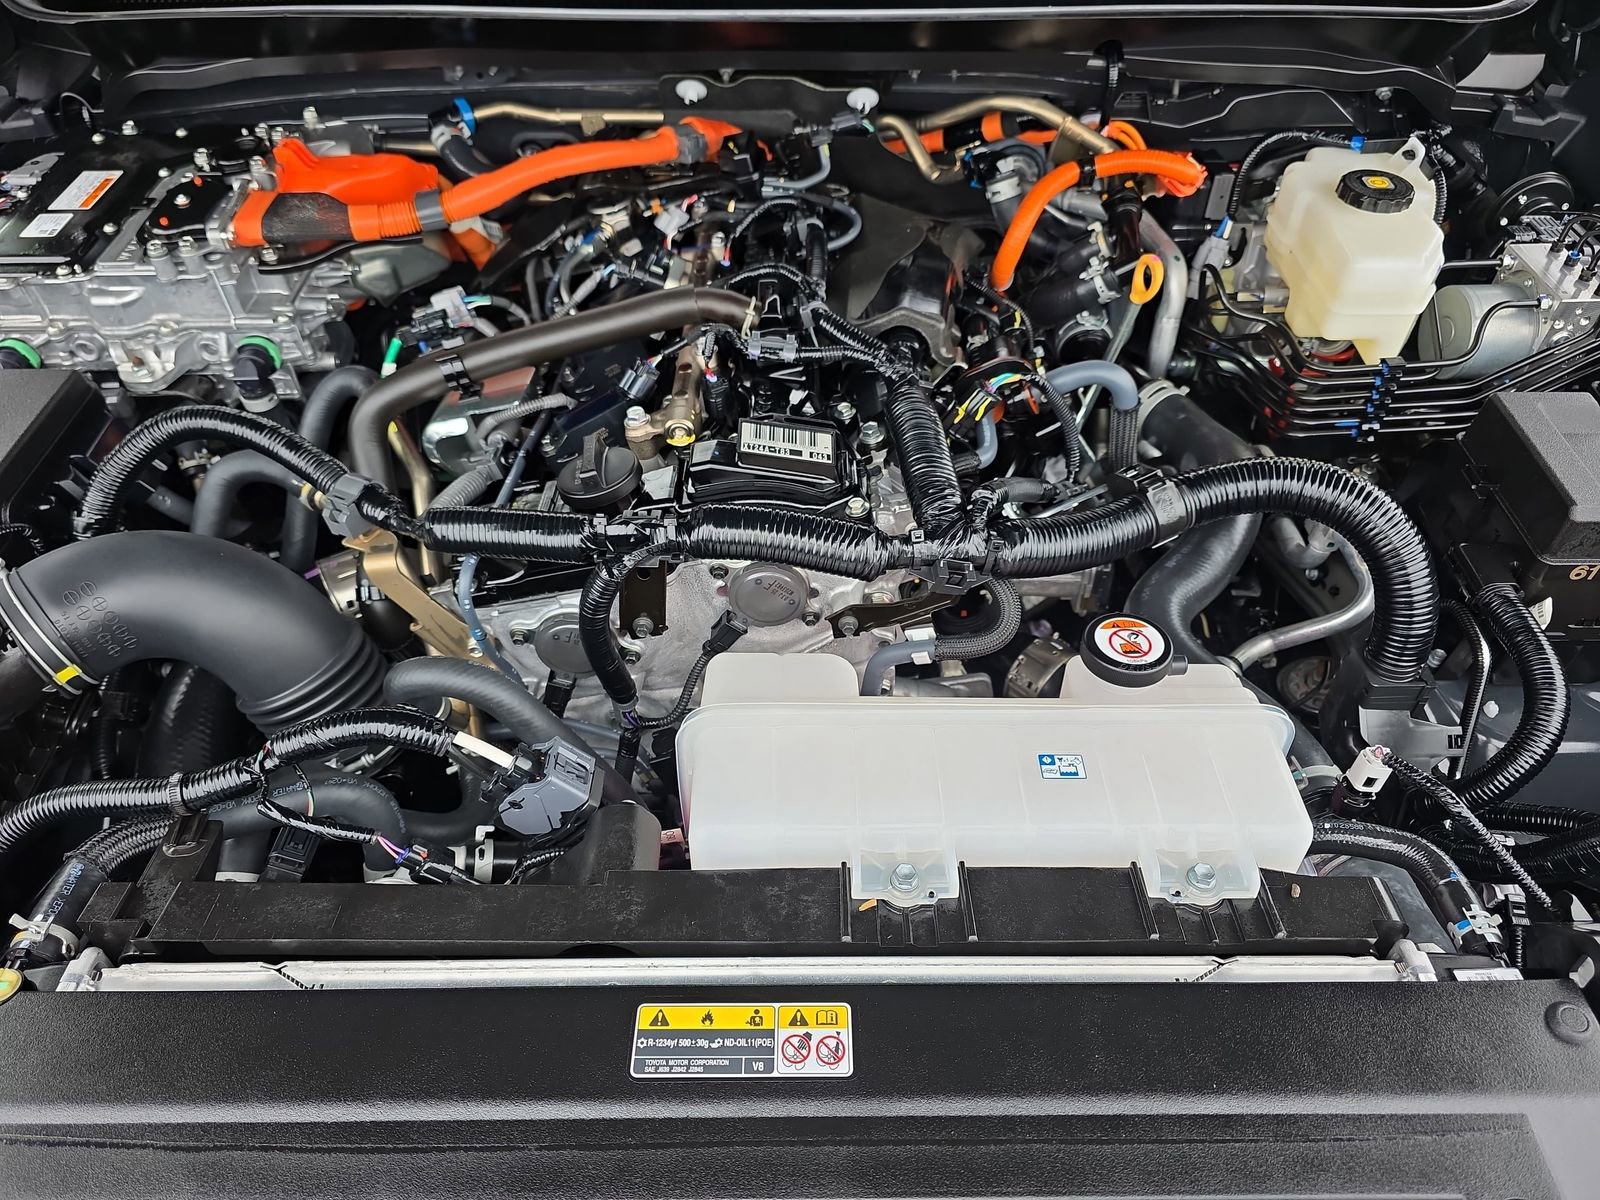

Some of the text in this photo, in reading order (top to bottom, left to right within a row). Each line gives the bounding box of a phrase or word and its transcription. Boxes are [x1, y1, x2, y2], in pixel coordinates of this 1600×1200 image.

[647, 1038, 677, 1048] R-1234yf
[724, 1038, 774, 1048] ND-OIL11(POE)
[752, 1061, 764, 1071] V8
